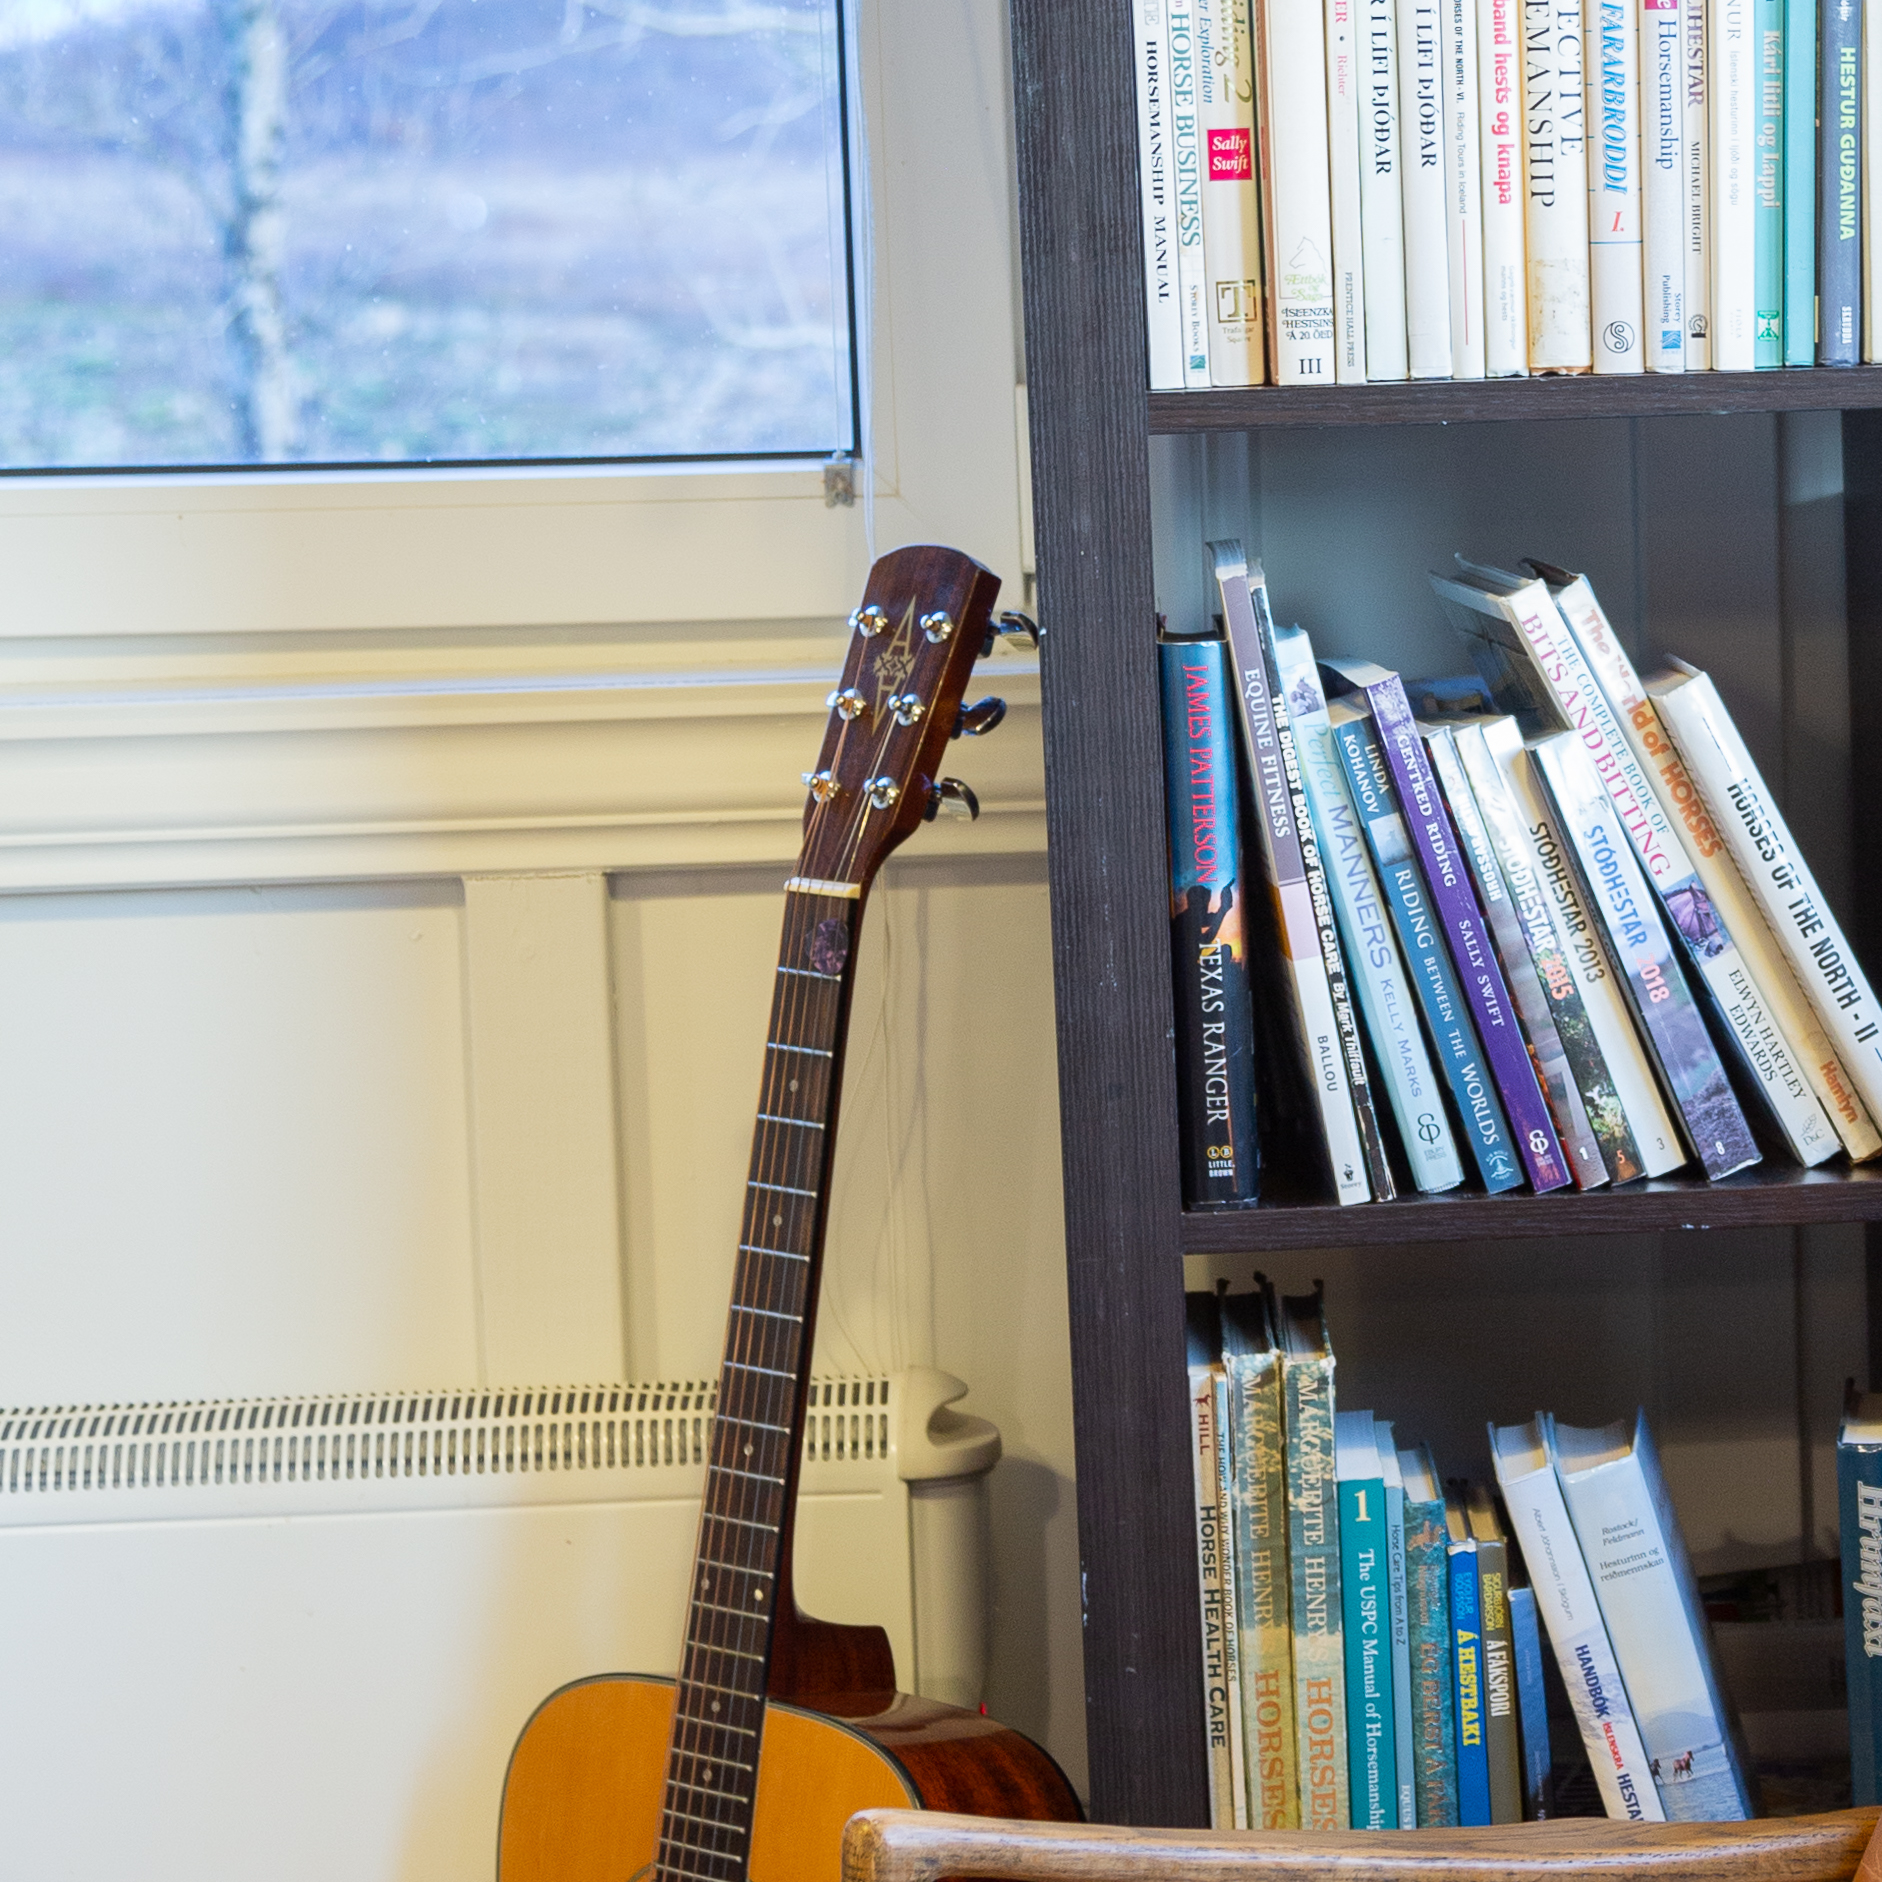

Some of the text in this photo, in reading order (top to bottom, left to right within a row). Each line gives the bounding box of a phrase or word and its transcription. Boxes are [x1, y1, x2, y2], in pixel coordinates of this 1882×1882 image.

[1371, 15, 1391, 23] Í
[1417, 8, 1436, 16] Í
[1171, 13, 1194, 107] HORSE
[1198, 17, 1214, 103] Exploration
[1337, 55, 1348, 96] Richter
[1371, 31, 1393, 76] LÍFI
[1417, 24, 1438, 69] LÍFI
[1223, 74, 1253, 103] 2
[1495, 53, 1512, 103] hests
[1656, 20, 1678, 169] Horsemanship
[1146, 41, 1164, 205] HORSEMANSHIP
[1372, 85, 1395, 175] ÞJÓÐAR
[1417, 78, 1439, 168] ÞJÓÐAR
[1492, 112, 1511, 135] og
[1840, 47, 1856, 240] HESTUR GUÐANNA
[1176, 114, 1200, 247] BUSINESS
[1456, 112, 1467, 214] Riding Tours in Iceland
[1493, 144, 1515, 204] knapa
[1154, 216, 1169, 304] MANUAL
[1343, 734, 1379, 814] KOHANOV
[1364, 745, 1390, 794] LINDA
[1521, 614, 1673, 878] BITS AND BITTING
[1183, 665, 1230, 1125] JAMES PATTERSON TEXAS RANGER
[1244, 668, 1338, 1092] EQUINE FITNESS BALLOU
[1396, 735, 1505, 1027] CENTRED RIDING SALLY SWIFT
[1394, 869, 1499, 1145] RIDING BETWEEN THE WORLDS
[1728, 968, 1806, 1101] ELWYN HARTLEY
[1728, 1005, 1777, 1082] EDWARDS
[1358, 1549, 1374, 1581] The
[1392, 1525, 1402, 1551] Horse
[1393, 1553, 1402, 1573] Care
[1599, 1547, 1659, 1570] Hesturinn og
[1198, 1414, 1226, 1748] HILL HORSE HEALTH CARE
[1360, 1585, 1377, 1634] USPC
[1392, 1576, 1403, 1592] Tips
[1395, 1595, 1404, 1615] from
[1396, 1627, 1404, 1636] to
[1363, 1639, 1380, 1698] Manual
[1532, 1508, 1547, 1532] Albert
[1575, 1644, 1610, 1718] HANDBÓK
[1602, 1722, 1624, 1770] ÍSLENSKRA
[1615, 1773, 1645, 1821] HESTA
[1366, 1703, 1380, 1718] of
[1402, 1785, 1412, 1823] EQUUS
